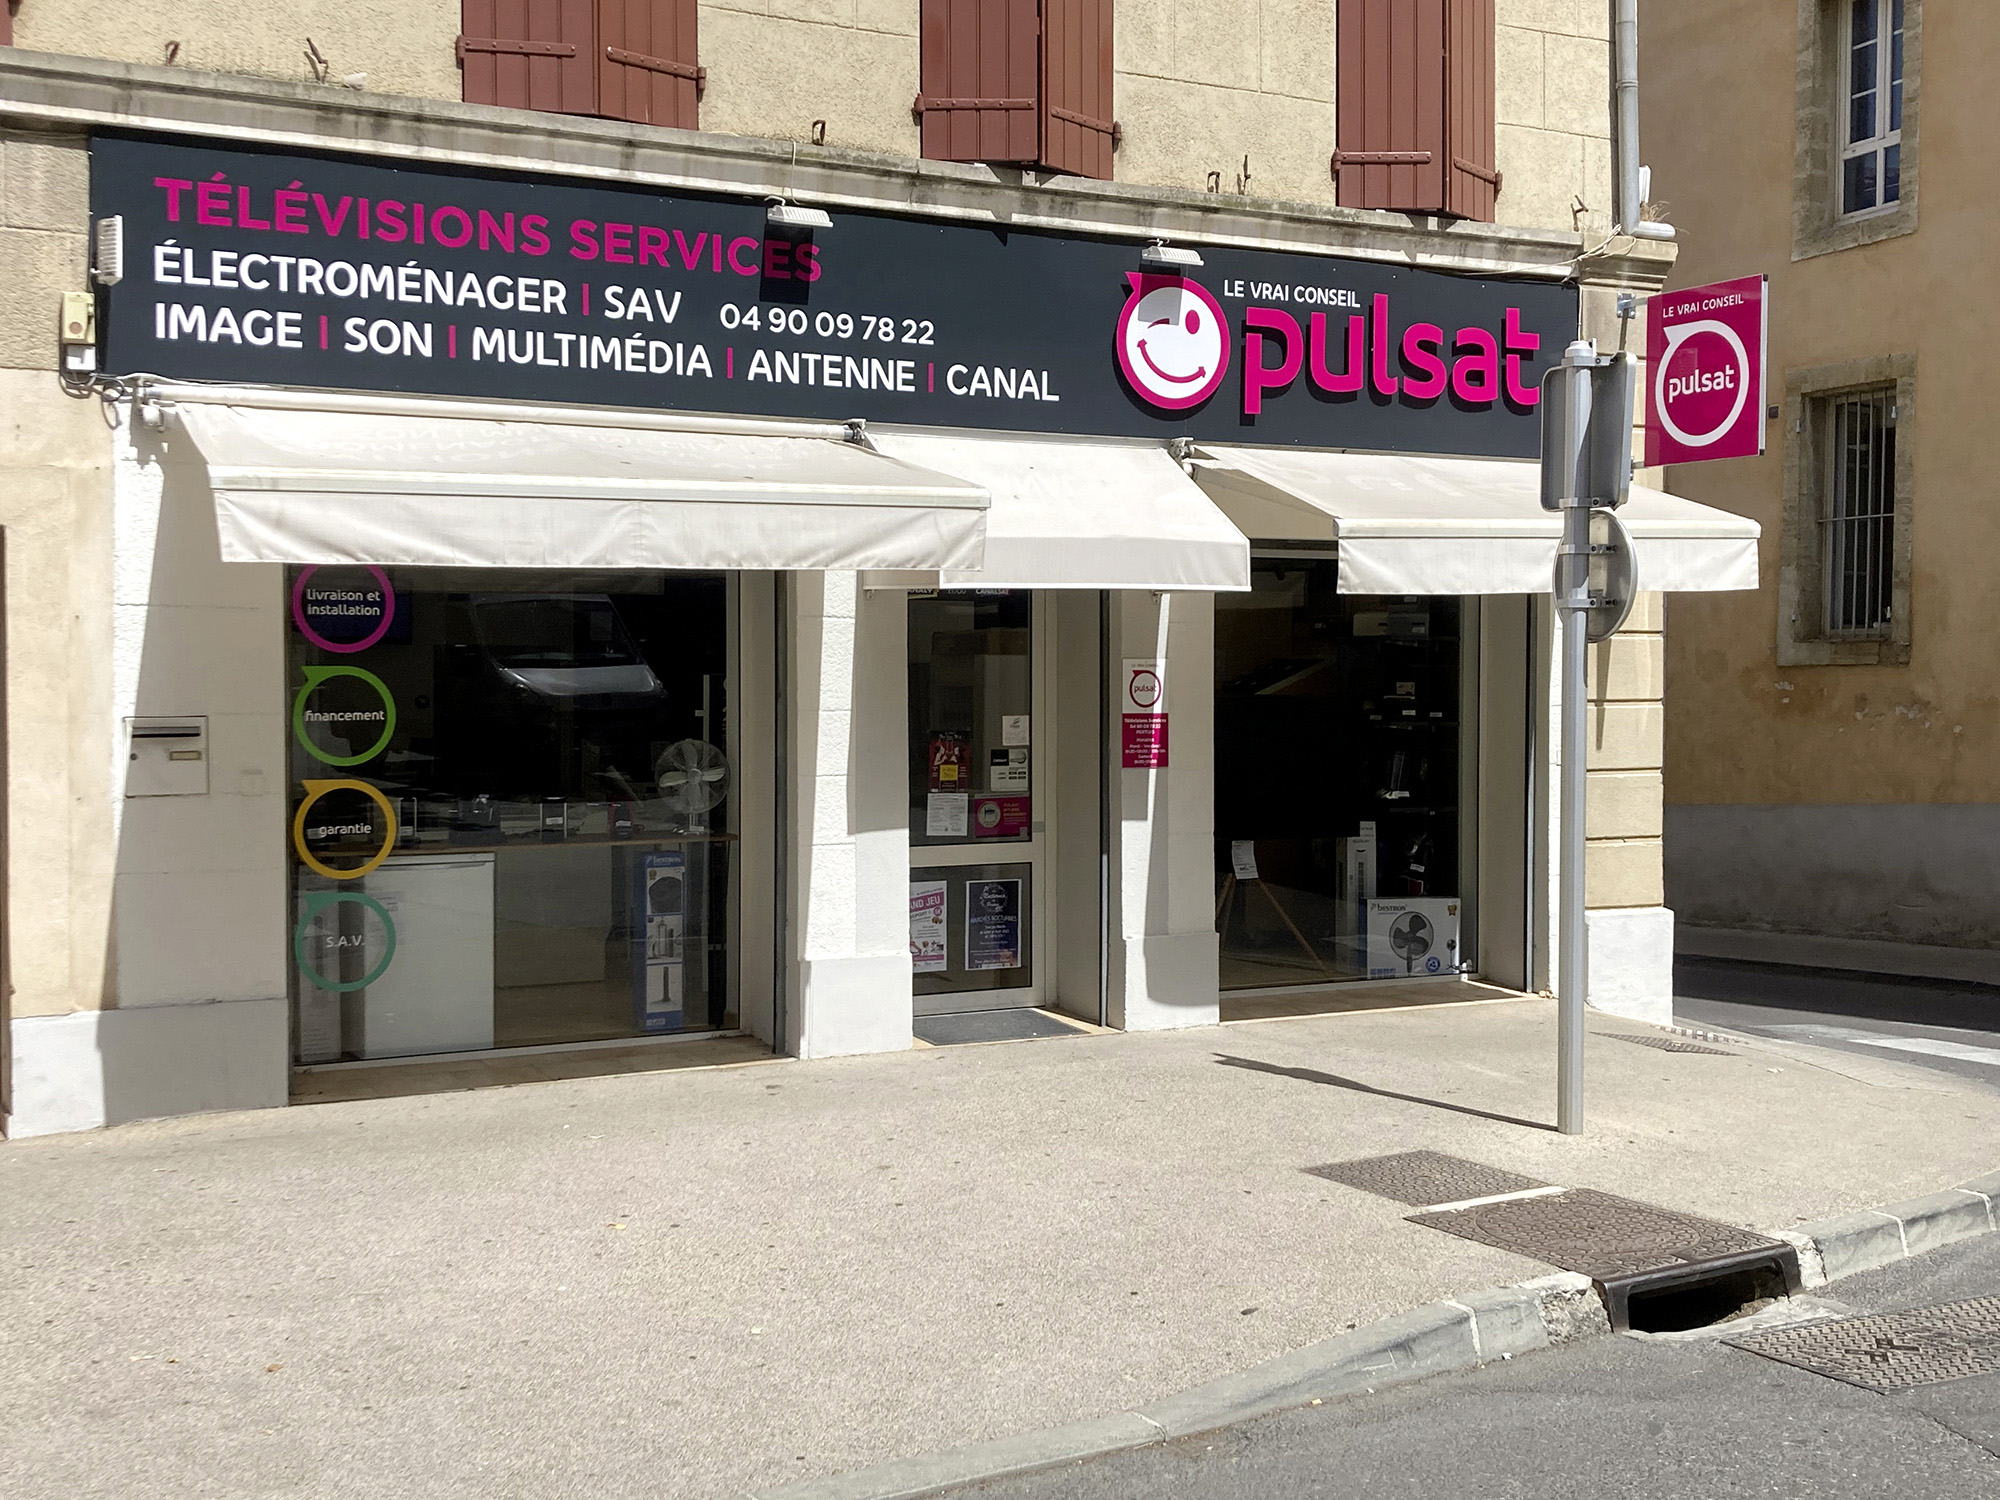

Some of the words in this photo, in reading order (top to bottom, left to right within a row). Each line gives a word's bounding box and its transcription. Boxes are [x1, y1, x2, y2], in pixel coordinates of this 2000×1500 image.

[154, 172, 550, 256] TÉLÉVISIONS
[569, 219, 823, 283] SERVICES
[154, 238, 568, 315] ÉLECTROMÉNAGER
[605, 286, 682, 324] SAV
[1223, 279, 1245, 298] LE
[1249, 281, 1289, 302] VRAI
[1293, 285, 1361, 309] CONSEIL
[1662, 306, 1675, 318] LE
[1677, 302, 1700, 315] VRAI
[1702, 294, 1745, 311] CONSEIL
[720, 303, 762, 331] 04
[768, 308, 808, 335] 90
[814, 312, 854, 339] 09
[861, 316, 895, 342] 78
[901, 319, 935, 346] 22
[154, 302, 303, 349] IMAGE
[344, 316, 433, 358] SON
[473, 326, 713, 378] MULTIMÉDIA
[748, 349, 916, 393] ANTENNE
[946, 364, 1060, 402] CANAL
[1243, 293, 1542, 416] pulsat
[1668, 364, 1735, 404] pulsat
[306, 588, 364, 601] livraison
[366, 590, 381, 602] et
[308, 603, 381, 616] installation
[304, 709, 385, 722] financement
[319, 822, 372, 838] garantie
[925, 895, 940, 907] JEU
[326, 934, 366, 948] S.A.V.
